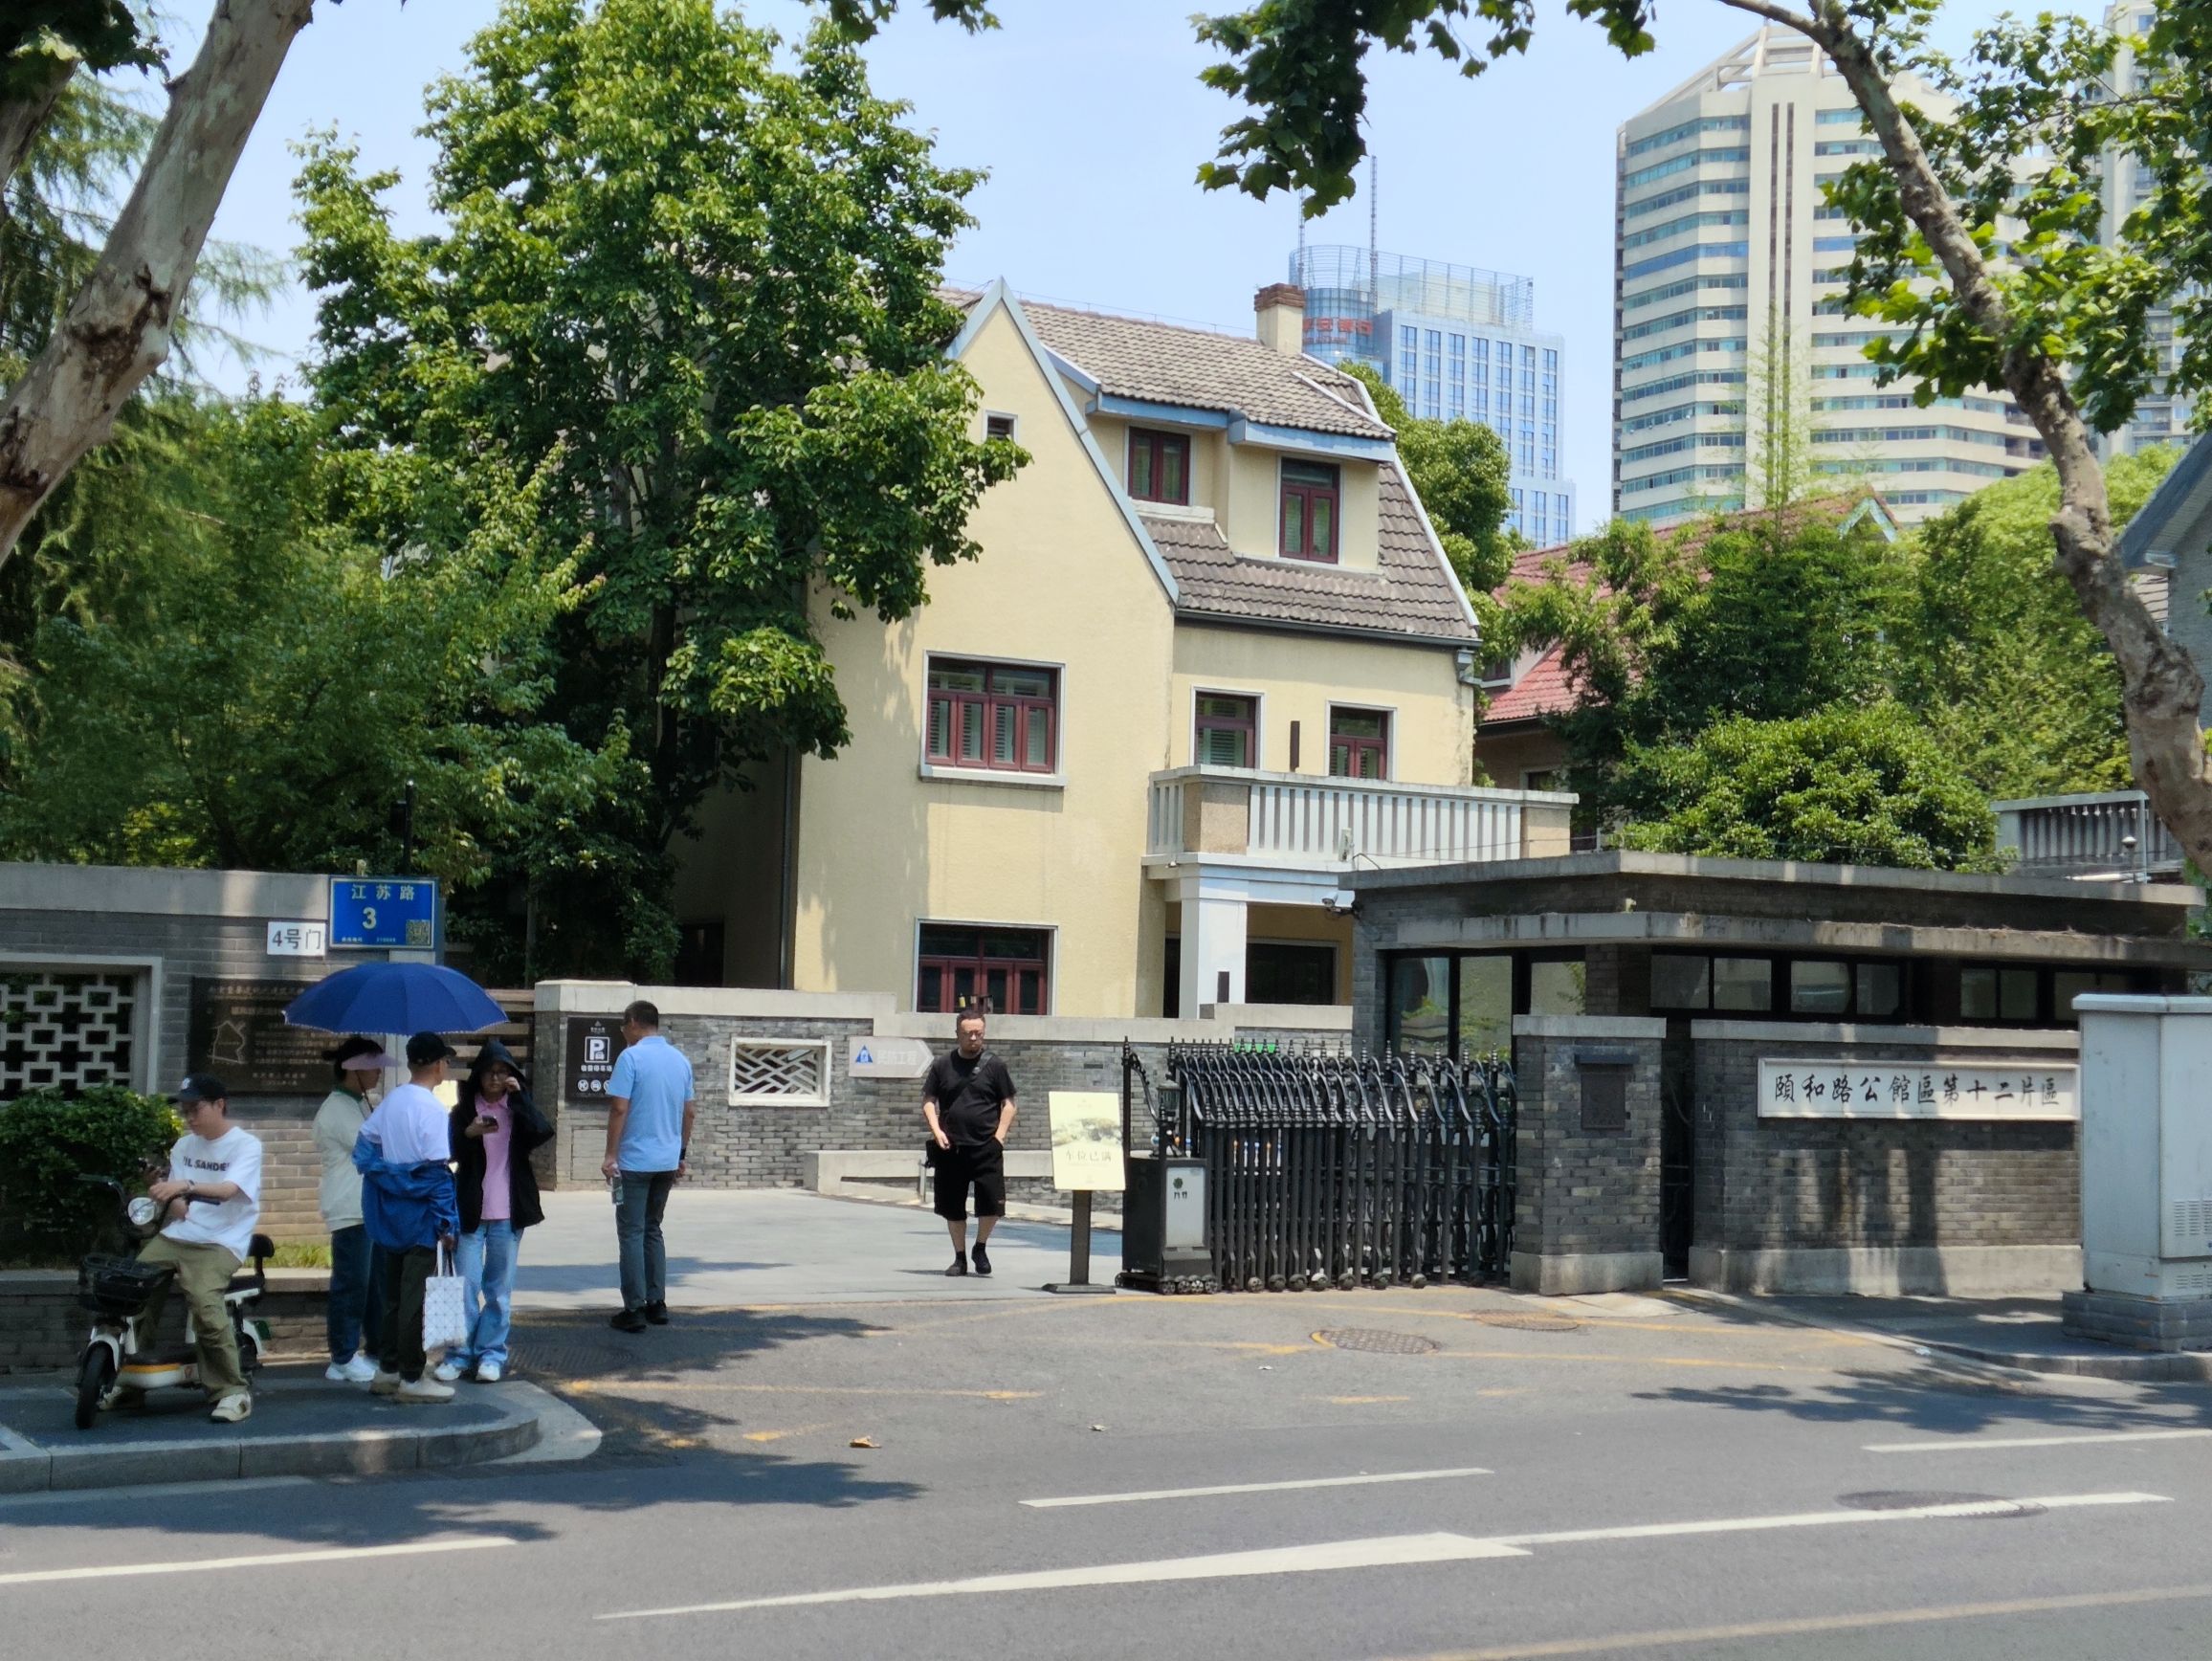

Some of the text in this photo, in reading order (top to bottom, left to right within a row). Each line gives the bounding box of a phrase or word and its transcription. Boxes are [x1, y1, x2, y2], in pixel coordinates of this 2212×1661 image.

[351, 884, 415, 900] 江苏路
[362, 907, 377, 929] 3
[272, 928, 321, 950] 4号门
[589, 1039, 605, 1060] P
